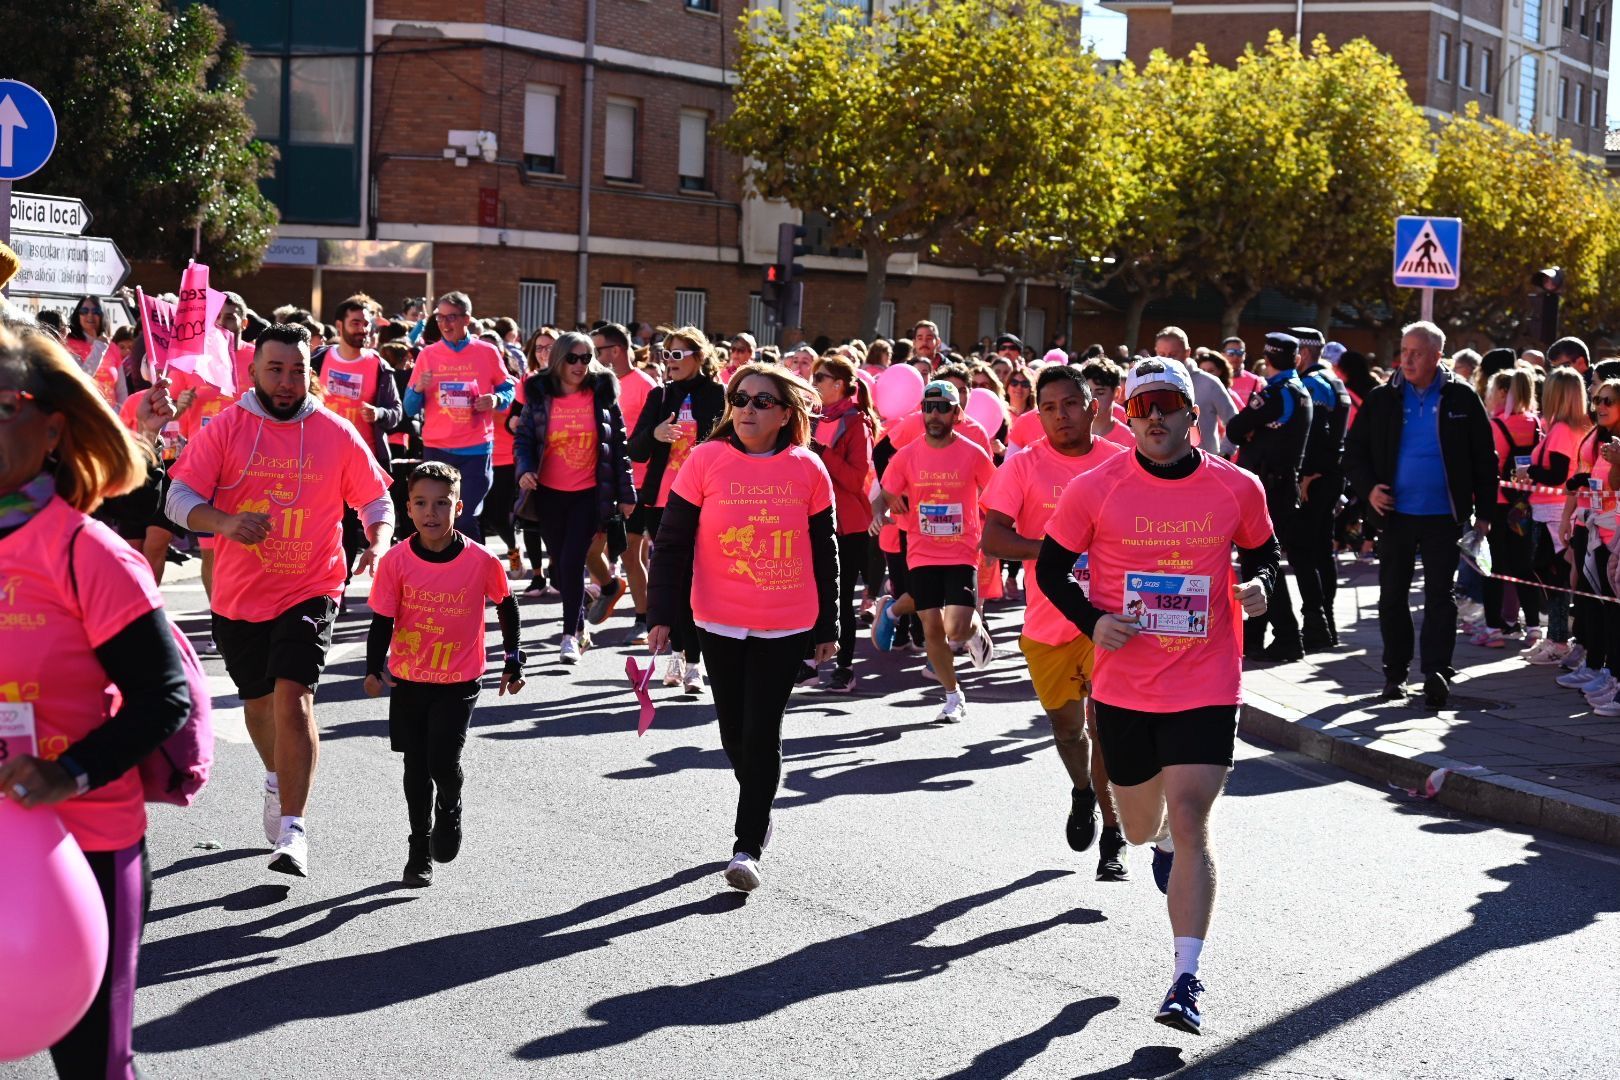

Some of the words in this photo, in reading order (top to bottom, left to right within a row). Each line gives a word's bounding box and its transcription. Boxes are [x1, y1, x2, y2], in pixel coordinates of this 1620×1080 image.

[10, 200, 45, 222] olicia
[49, 202, 81, 226] local
[29, 244, 60, 260] escolar
[269, 245, 305, 255] OSIVOS
[250, 451, 314, 470] Drasanvi
[919, 469, 959, 480] Drasanvi
[730, 481, 793, 496] Drasanvi
[1135, 511, 1214, 534] Drasanvi
[263, 538, 313, 552] Carrera
[275, 550, 312, 563] Mujer
[755, 557, 803, 570] Carrera
[403, 584, 467, 604] Drasanvi
[1155, 594, 1192, 610] 1327
[412, 667, 463, 682] Carrera
